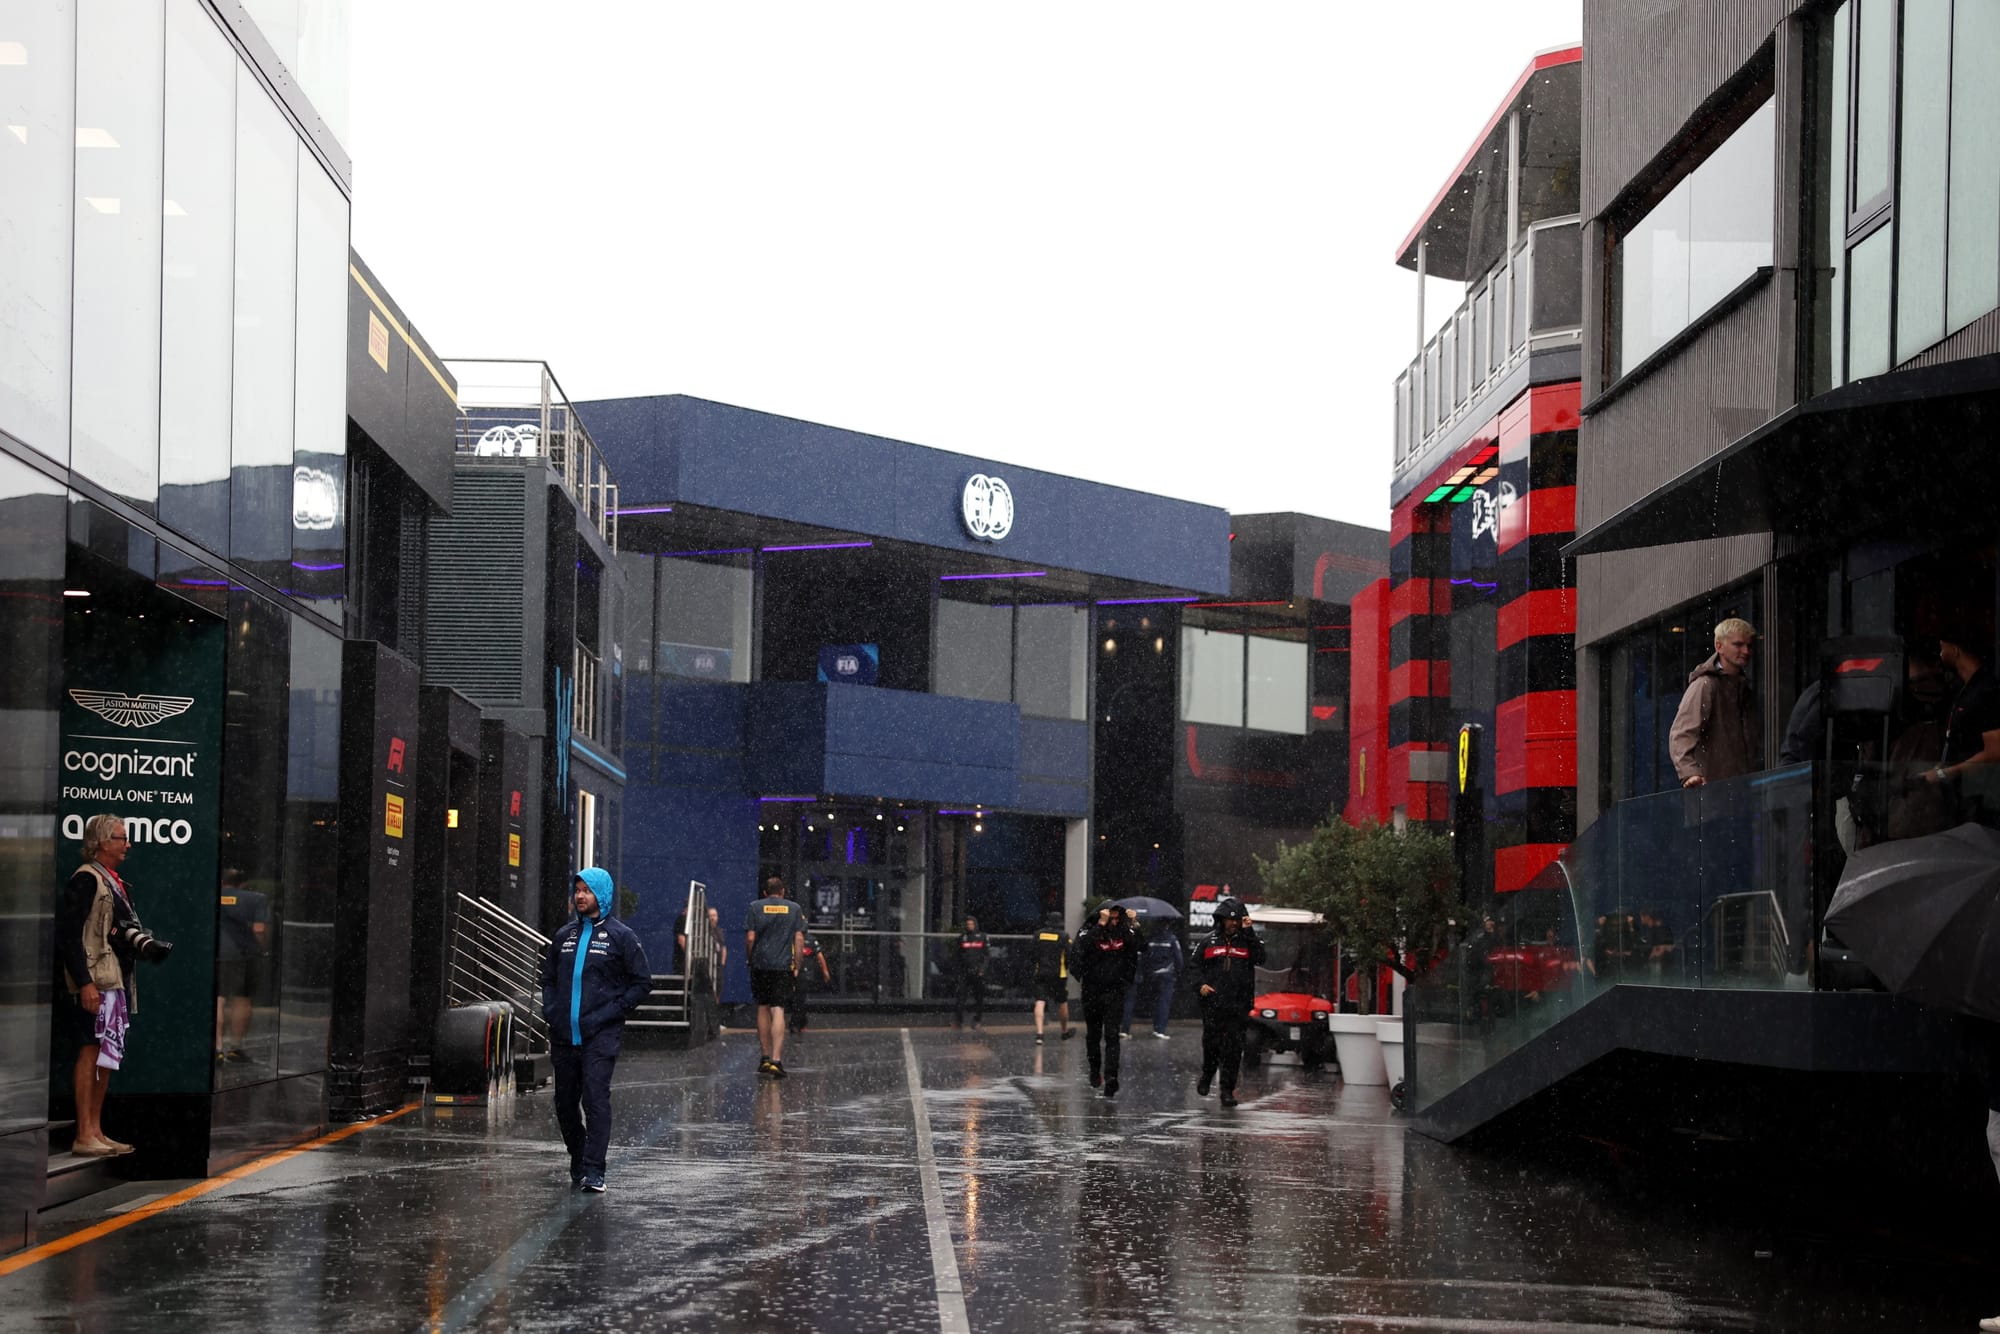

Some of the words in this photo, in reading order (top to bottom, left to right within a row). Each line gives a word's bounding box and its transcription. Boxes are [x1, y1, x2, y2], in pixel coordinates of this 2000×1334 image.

[836, 657, 858, 672] FIA
[105, 699, 130, 709] ASTON
[130, 701, 159, 711] MARTIN
[64, 748, 195, 781] cognizant
[63, 786, 123, 801] FORMULA
[127, 789, 154, 802] ONE
[160, 791, 193, 804] TEAM
[62, 814, 192, 845] amco
